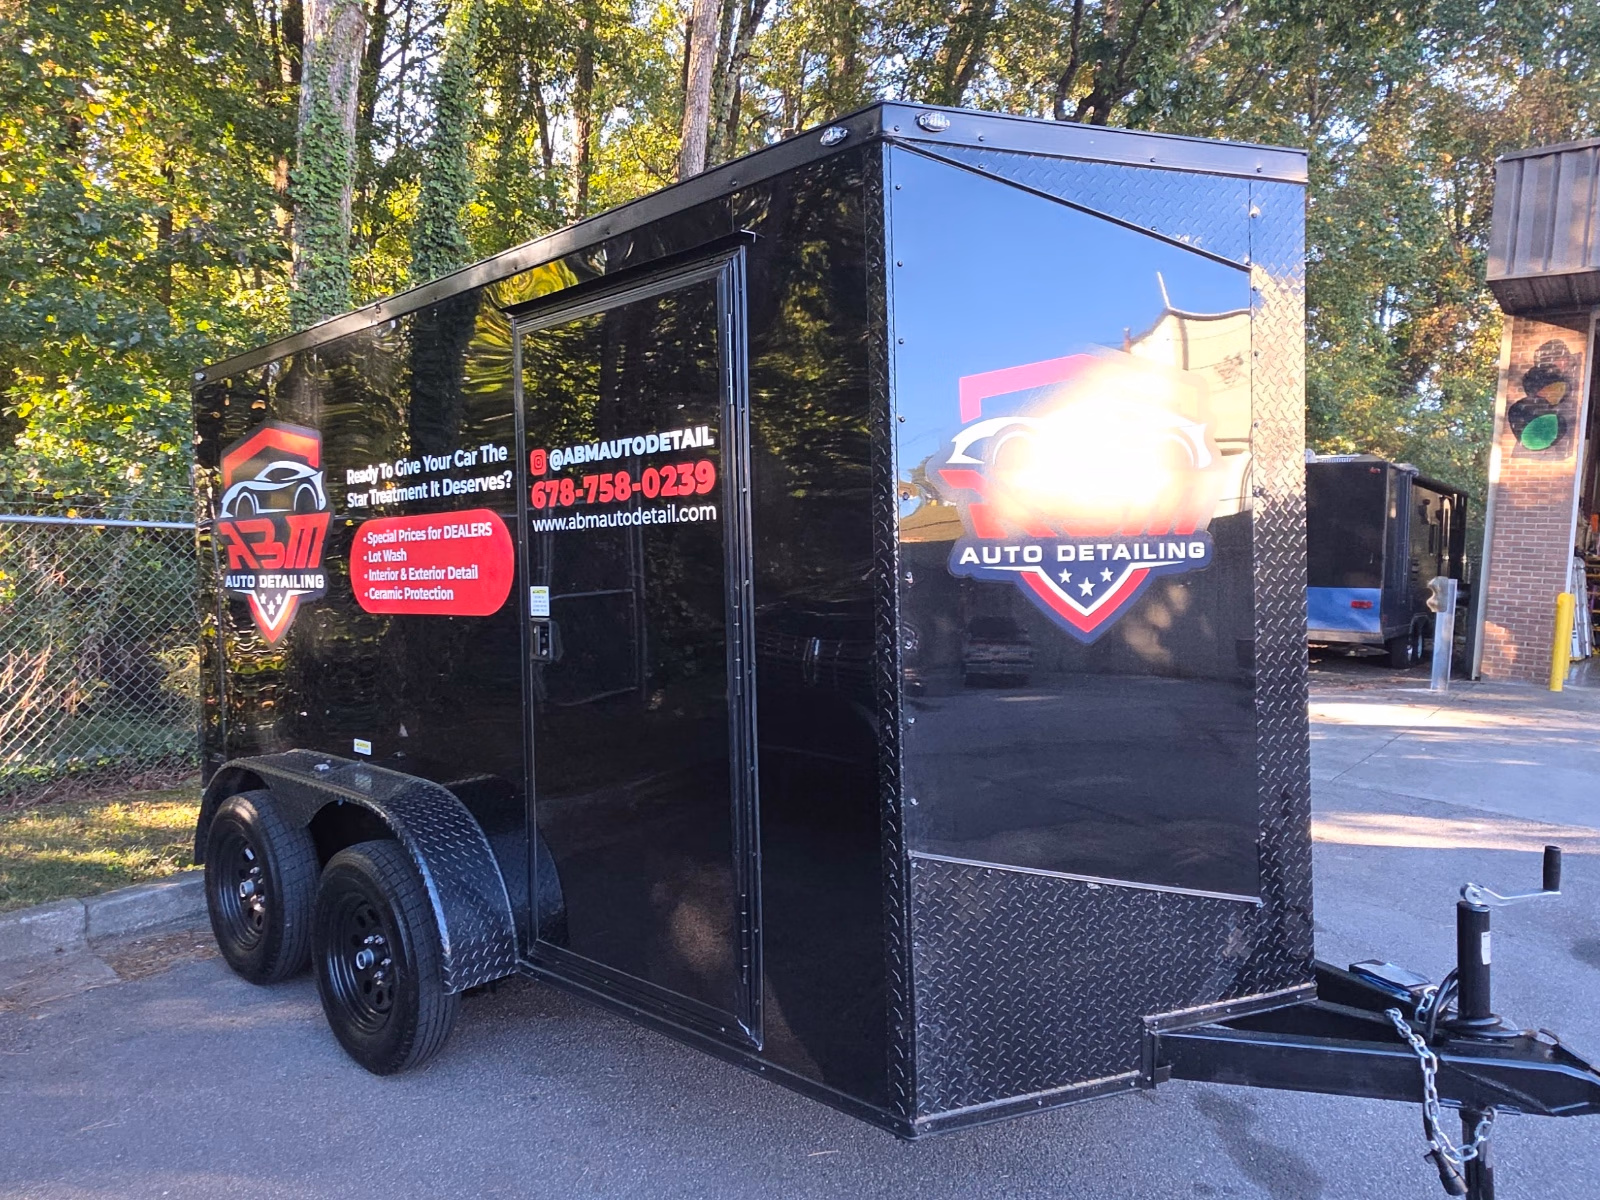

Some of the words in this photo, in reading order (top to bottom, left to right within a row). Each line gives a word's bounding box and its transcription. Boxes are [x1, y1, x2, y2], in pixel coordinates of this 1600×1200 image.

[549, 426, 714, 471] @ABMAUTODETAIL
[346, 464, 379, 485] Ready
[379, 462, 394, 480] To
[394, 457, 421, 477] Give
[422, 454, 452, 472] Your
[454, 448, 478, 468] Car
[480, 443, 508, 464] The
[347, 492, 369, 508] Star
[369, 483, 428, 506] Treatment
[430, 480, 441, 498] It
[442, 470, 513, 494] Deserves?
[531, 460, 716, 510] 678-758-0239
[532, 504, 717, 532] www.abmautodetail.com
[367, 529, 397, 547] Special
[398, 528, 426, 543] Prices
[427, 525, 442, 541] for
[443, 522, 493, 539] DEALERS
[368, 550, 382, 563] Lot
[382, 548, 407, 562] Wash
[959, 545, 1043, 565] AUTO
[1057, 541, 1206, 562] DETAILING
[224, 575, 256, 589] AUTO
[258, 574, 325, 589] DETAILING
[368, 567, 399, 582] Interior
[400, 567, 408, 581] &
[408, 565, 446, 581] Exterior
[447, 564, 479, 580] Detail
[368, 586, 404, 600] Ceramic
[404, 586, 454, 601] Protection
